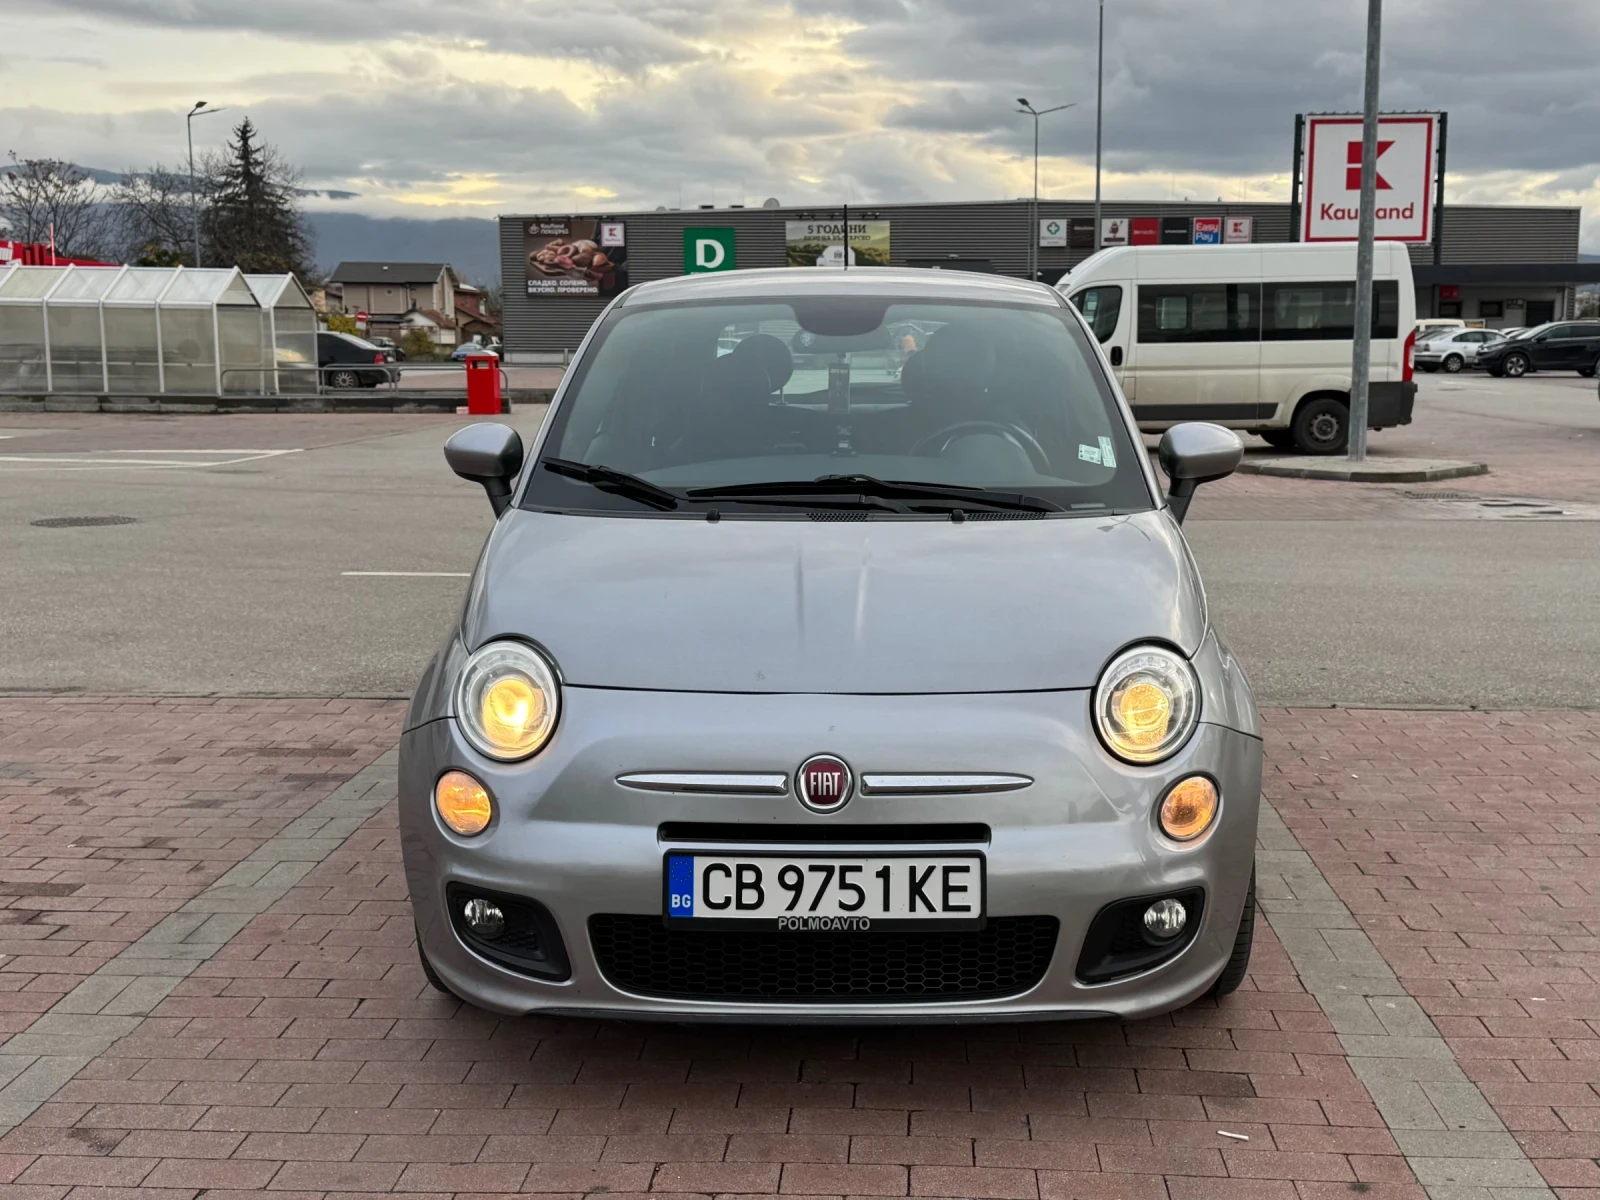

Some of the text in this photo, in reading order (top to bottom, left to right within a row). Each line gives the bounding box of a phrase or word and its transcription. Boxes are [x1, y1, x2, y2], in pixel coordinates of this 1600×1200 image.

[1345, 140, 1396, 190] K
[1320, 202, 1414, 220] Kauand
[807, 225, 814, 234] 5
[1195, 222, 1219, 233] Easy
[1196, 232, 1214, 242] Pay
[696, 239, 725, 269] D
[810, 772, 841, 796] FIAT
[702, 863, 972, 913] CB 9751 KE
[671, 894, 691, 909] BG
[778, 916, 871, 931] POLMOAVTO
